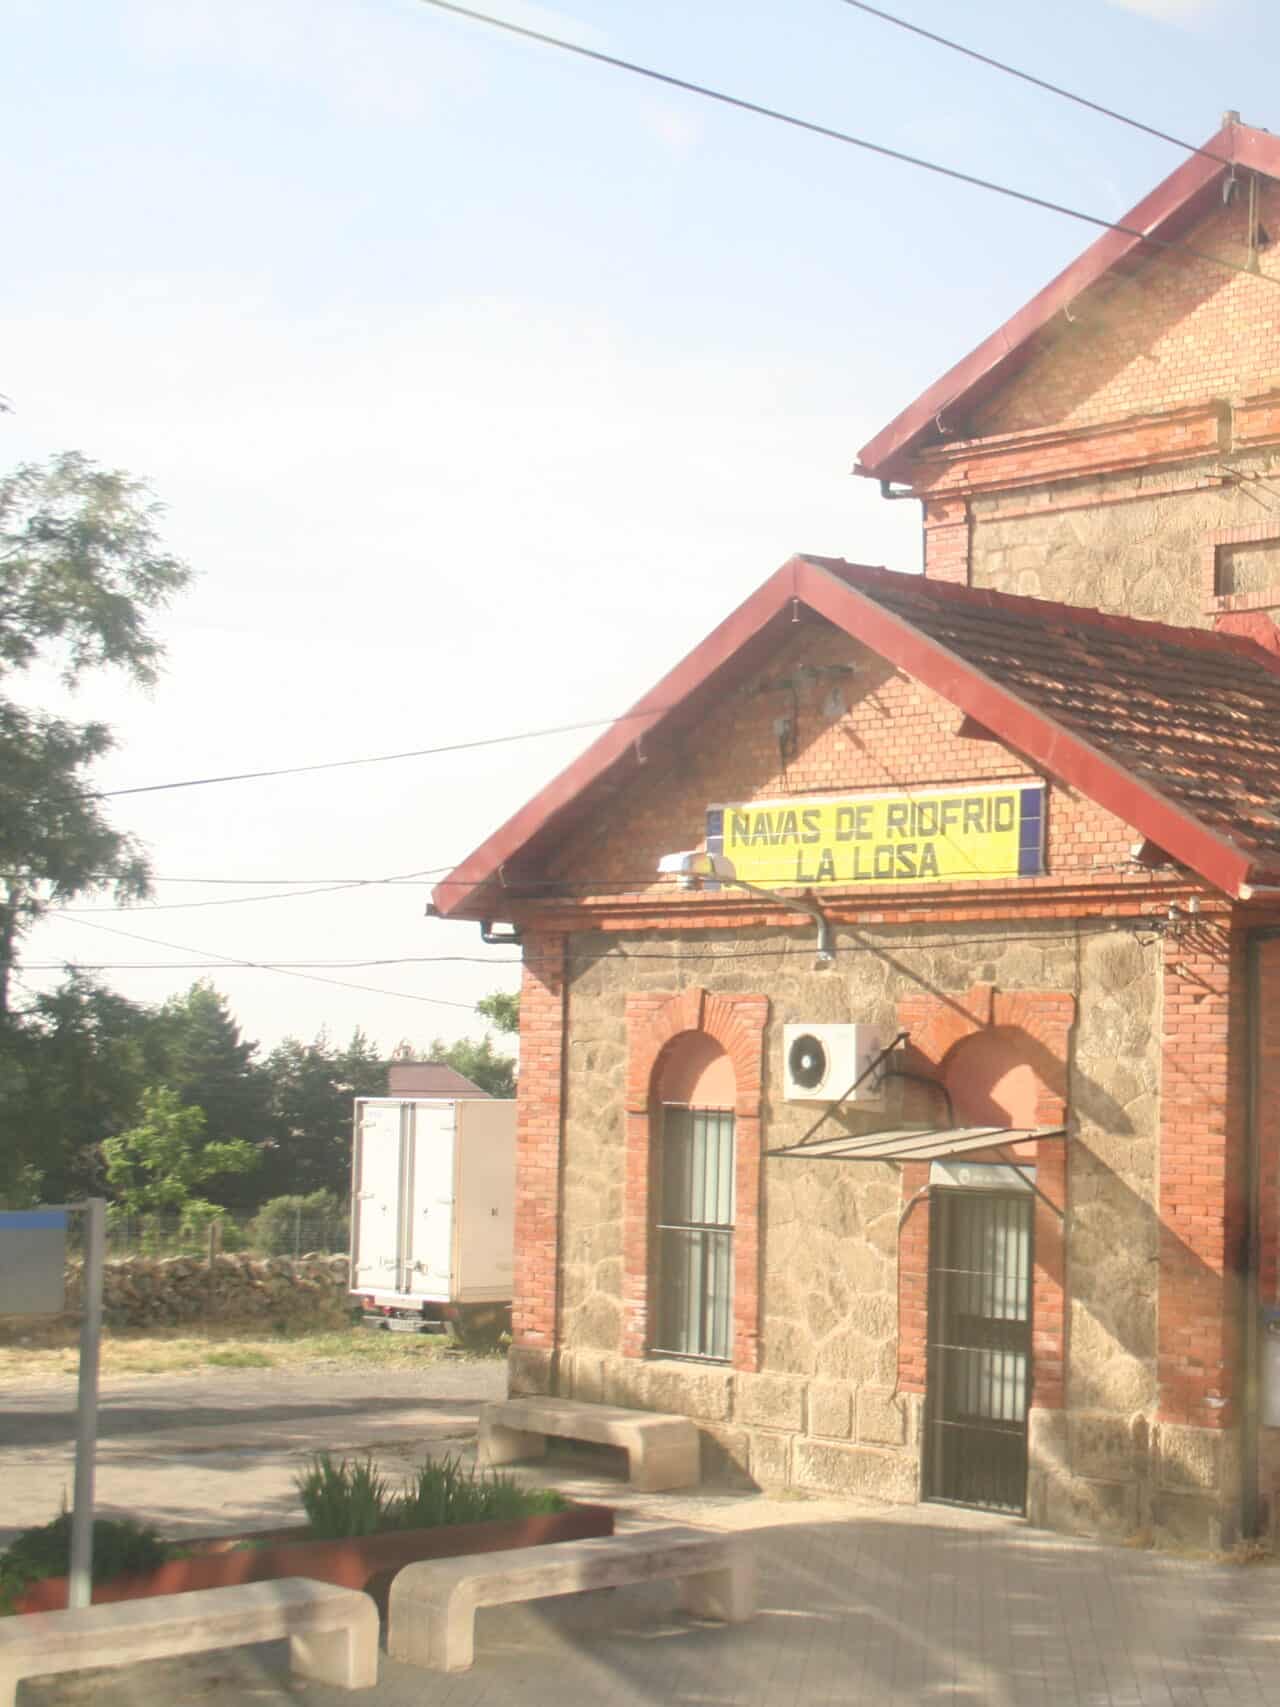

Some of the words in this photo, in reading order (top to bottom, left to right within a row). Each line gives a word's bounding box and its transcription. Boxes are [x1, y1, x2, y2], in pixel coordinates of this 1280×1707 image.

[730, 809, 821, 847] NAVAS
[835, 805, 874, 841] DE
[886, 796, 1016, 838] RIOFRIO
[796, 847, 836, 882] LA
[853, 842, 940, 880] LOSA
